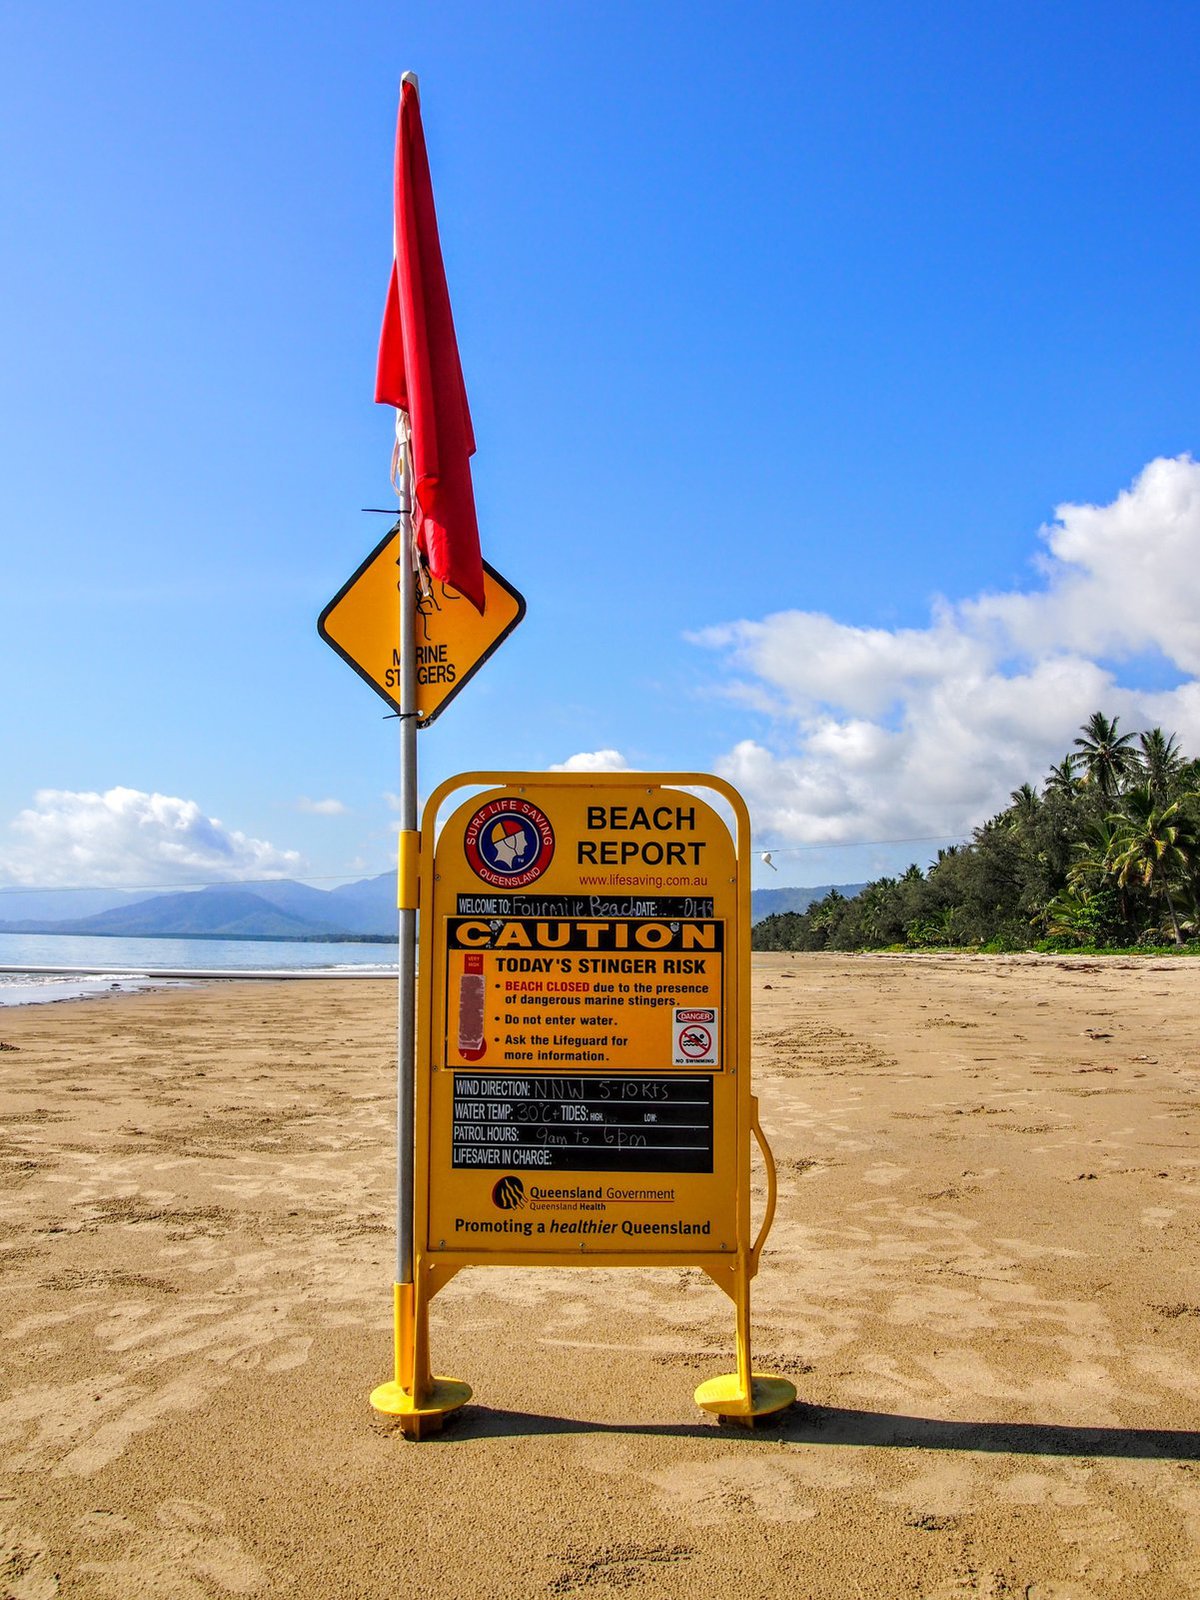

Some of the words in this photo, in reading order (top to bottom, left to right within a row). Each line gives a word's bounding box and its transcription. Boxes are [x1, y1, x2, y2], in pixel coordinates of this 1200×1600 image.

[393, 644, 448, 666] MRINE
[386, 664, 456, 687] STGERS
[466, 810, 486, 845] SURF
[489, 800, 516, 814] LIFE
[522, 804, 552, 845] SAVING
[587, 806, 695, 830] BEACH
[577, 841, 706, 865] REPORT
[480, 867, 540, 886] QUEENSLAND
[579, 874, 707, 888] www.lifesaving.com.au
[459, 898, 497, 914] WELCOME
[498, 899, 511, 914] TO:
[636, 902, 658, 916] DATE:
[456, 922, 715, 948] CAUTION
[496, 958, 572, 973] TODAY'S
[578, 958, 656, 974] STINGER
[663, 960, 706, 974] RISK
[505, 982, 543, 992] BEACH
[546, 982, 590, 992] CLOSED
[594, 983, 615, 992] due
[618, 984, 630, 992] to
[634, 984, 652, 993] the
[656, 986, 708, 996] presence
[505, 994, 517, 1004] of
[520, 996, 582, 1008] dangerous
[584, 996, 624, 1006] marine
[628, 996, 680, 1008] stingers.
[505, 1014, 520, 1024] Do
[523, 1016, 542, 1025] not
[546, 1016, 576, 1025] enter
[580, 1016, 618, 1026] water.
[505, 1036, 526, 1046] Ask
[530, 1036, 548, 1046] the
[553, 1036, 608, 1048] Lifeguard
[612, 1036, 628, 1046] for
[504, 1052, 534, 1060] more
[538, 1050, 610, 1061] information.
[456, 1080, 480, 1094] WIND
[481, 1080, 530, 1096] DIRECTION:
[534, 1079, 584, 1099] NNW
[455, 1103, 485, 1119] WATER
[487, 1104, 514, 1120] TEMP:
[561, 1105, 589, 1121] TIDES:
[454, 1126, 486, 1140] PATROL
[487, 1127, 520, 1141] HOURS:
[536, 1127, 568, 1150] 9am
[574, 1128, 590, 1144] to
[604, 1122, 646, 1152] 6pm
[454, 1148, 500, 1164] LIFESAVER
[502, 1149, 511, 1164] IN
[513, 1150, 552, 1165] CHARGE:
[530, 1187, 602, 1199] Queensland
[606, 1188, 674, 1200] Government
[530, 1202, 577, 1211] Queensland
[455, 1219, 532, 1236] Promoting
[537, 1224, 545, 1233] a
[550, 1220, 617, 1234] healthier
[622, 1221, 711, 1234] Queensland
